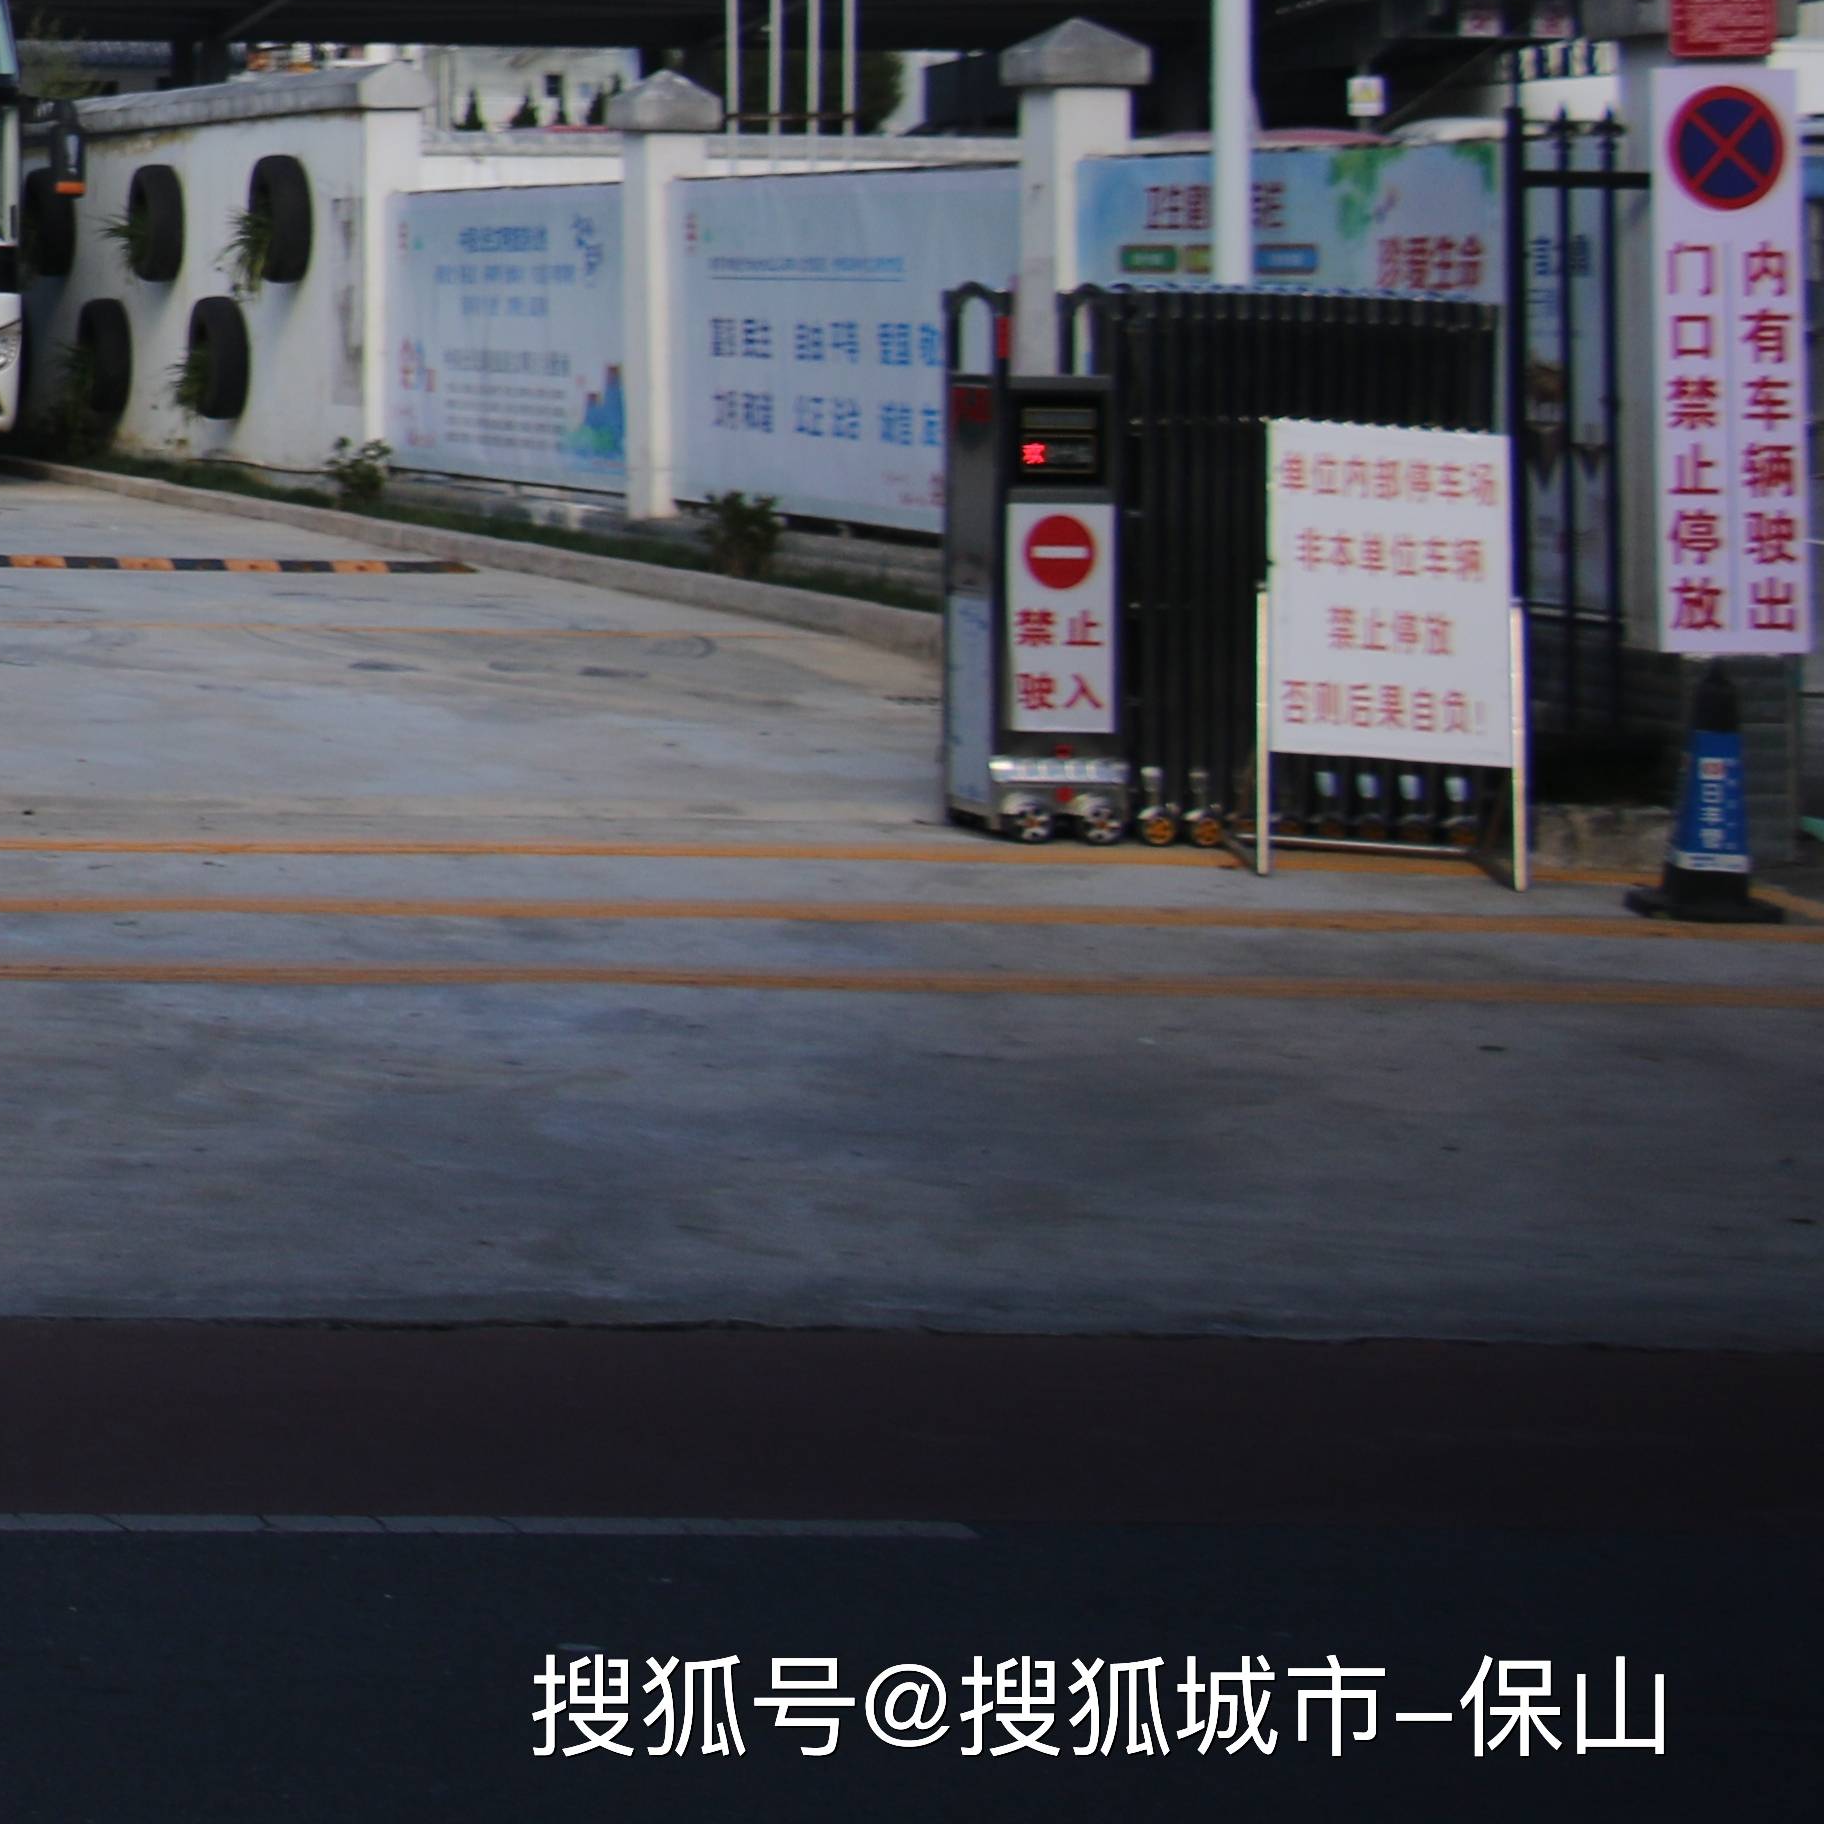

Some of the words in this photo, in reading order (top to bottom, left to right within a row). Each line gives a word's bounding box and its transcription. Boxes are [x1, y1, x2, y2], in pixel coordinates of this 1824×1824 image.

[1666, 242, 1725, 632] 门口禁止停放
[1739, 240, 1798, 632] 内有车辆驶出
[1281, 451, 1498, 506] 单位内部停车场
[1296, 528, 1485, 581] 非本单位车辆
[1014, 609, 1103, 647] 禁止
[1328, 606, 1455, 655] 禁止停放
[1015, 673, 1104, 710] 驶入
